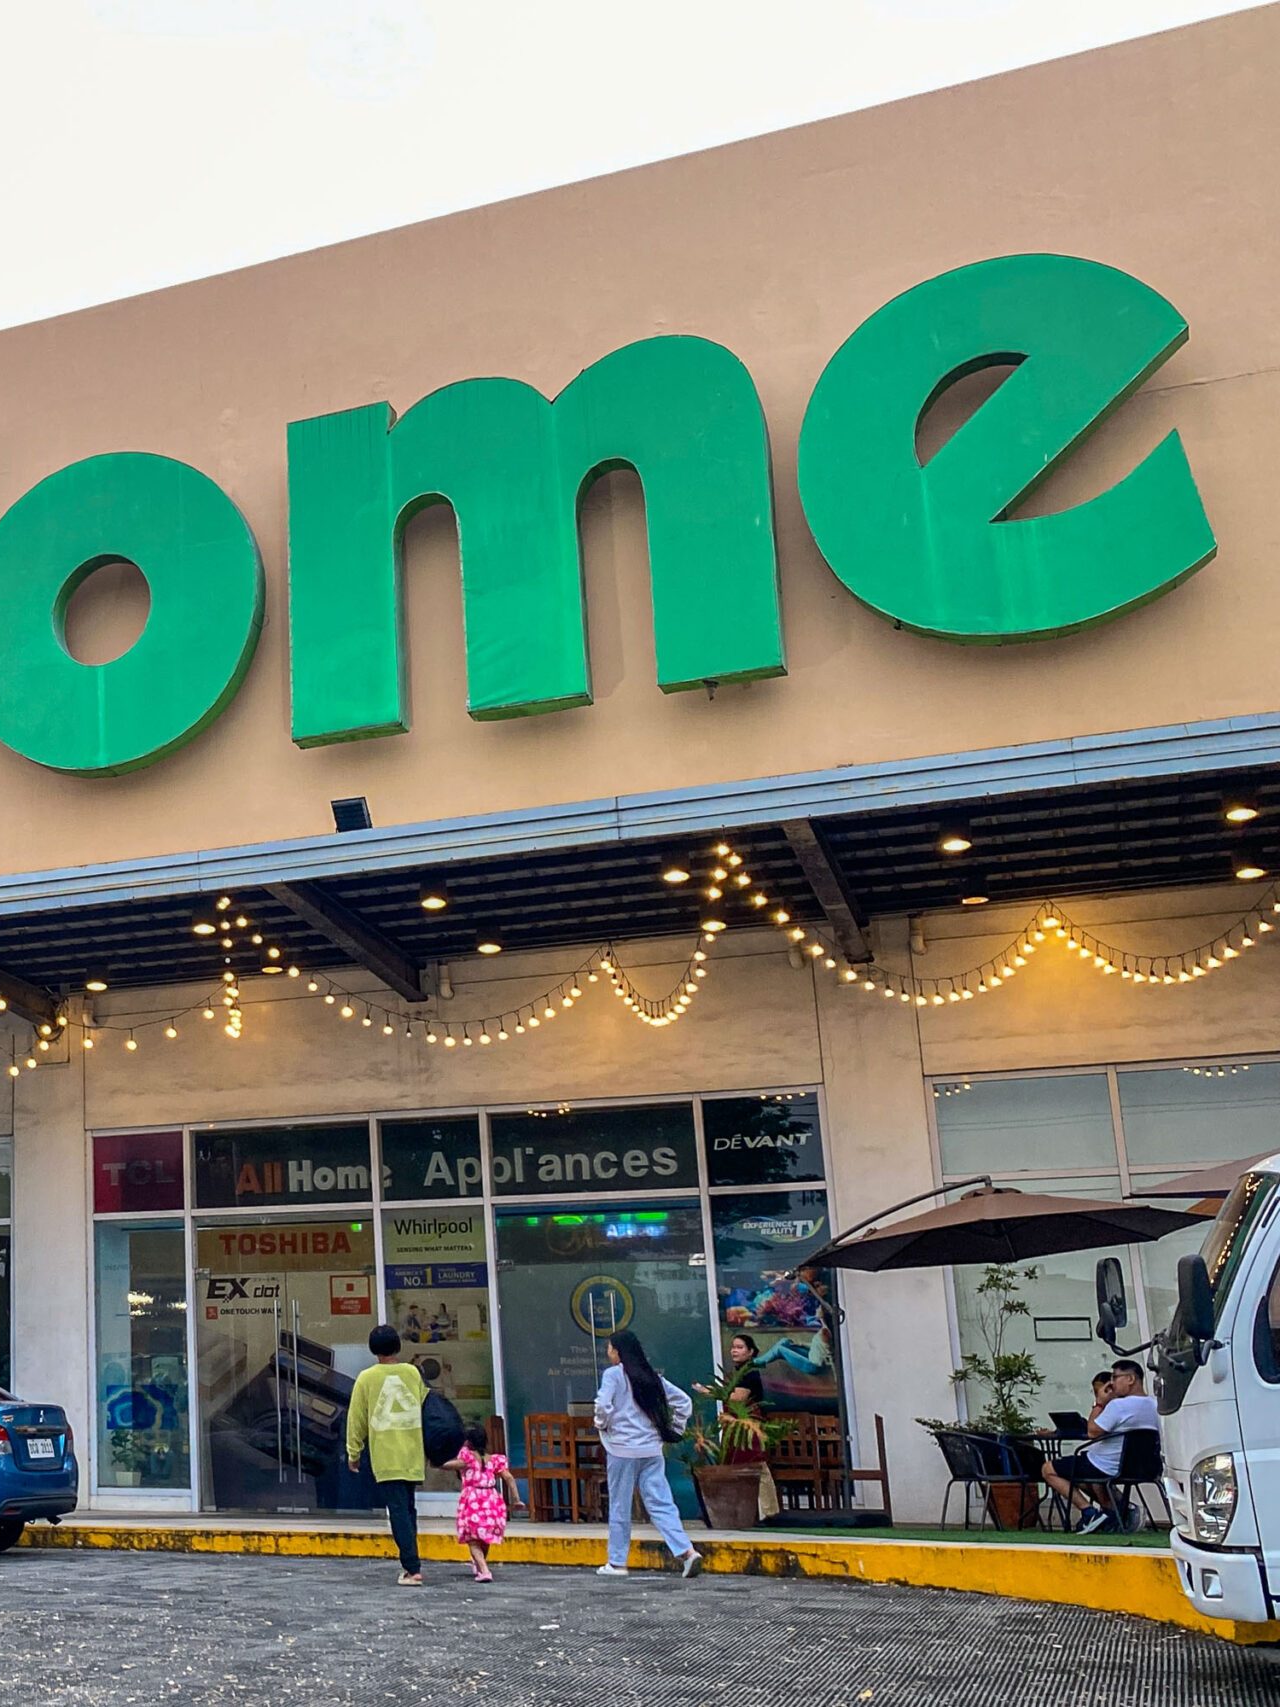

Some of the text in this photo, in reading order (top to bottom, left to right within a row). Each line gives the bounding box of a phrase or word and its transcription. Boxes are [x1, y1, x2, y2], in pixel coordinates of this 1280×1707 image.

[102, 1160, 176, 1186] TCL
[423, 1146, 678, 1196] Applances
[393, 1216, 473, 1239] Whirlpool
[742, 1220, 792, 1229] EXPERIENCE
[760, 1227, 795, 1235] REALITY
[219, 1231, 352, 1256] TOSHIBA
